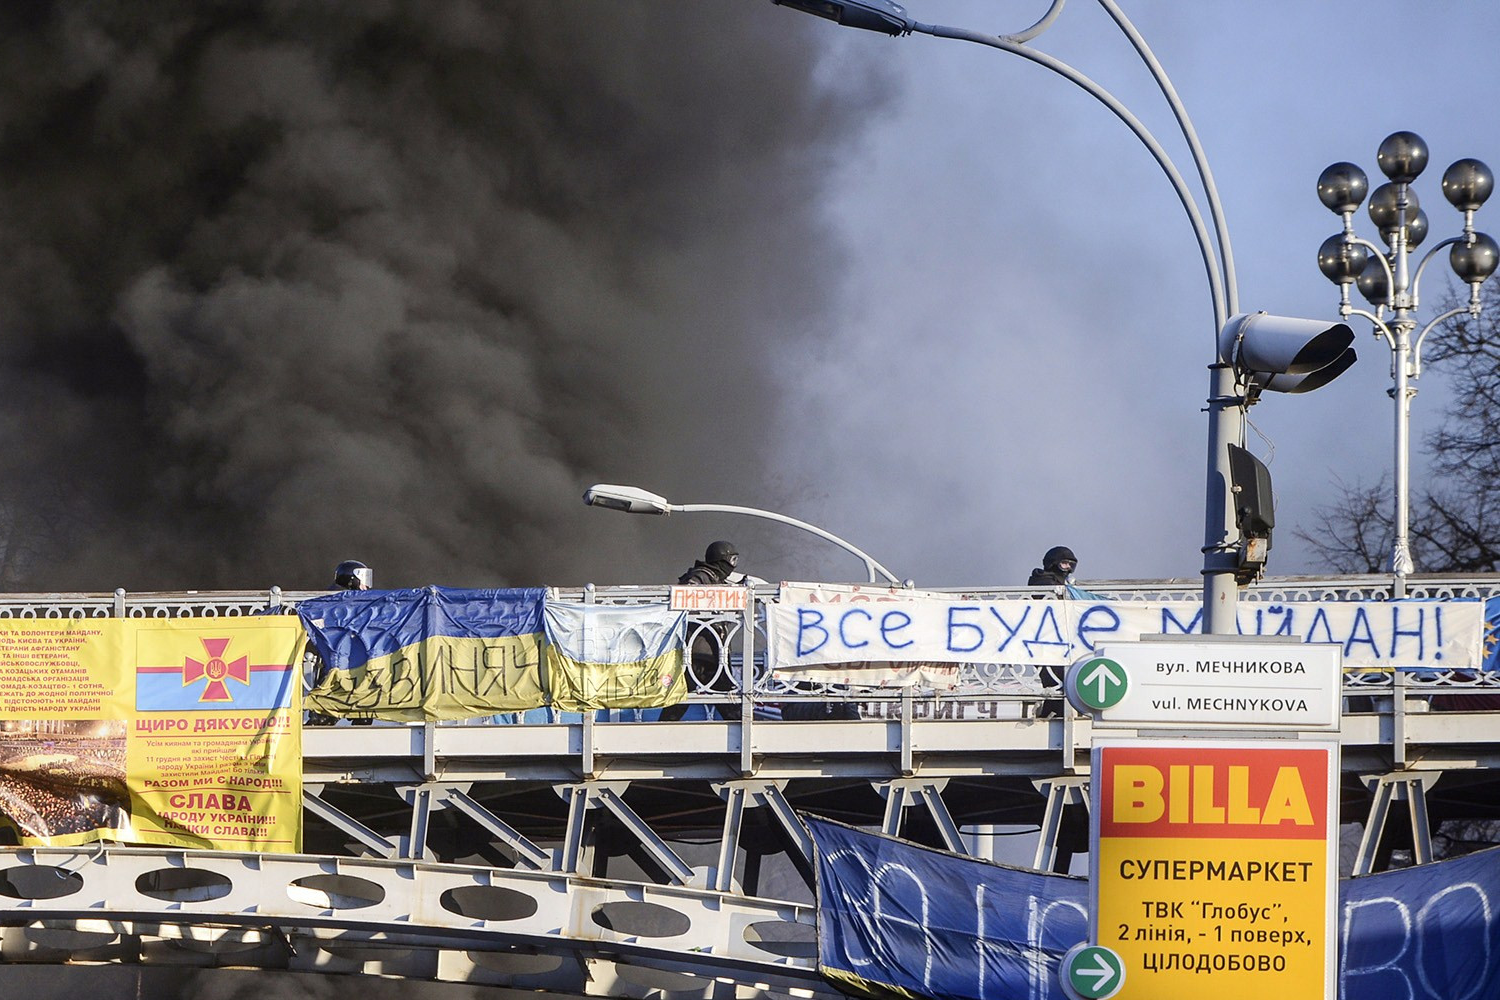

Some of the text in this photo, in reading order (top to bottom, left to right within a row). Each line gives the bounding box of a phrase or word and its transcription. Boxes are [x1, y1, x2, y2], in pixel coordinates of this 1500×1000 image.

[674, 588, 748, 610] ПИРЯТИН
[66, 629, 103, 637] МАЙДАНУ,
[1156, 660, 1306, 675] вул. МЕЧНИКОВА
[1152, 697, 1308, 712] vul. MECHNYKOVA
[135, 717, 291, 733] ЩИРО ДЯКУЄМО!!!
[144, 775, 283, 788] РАЗОМ МИ Є НАРОД!!!
[169, 793, 253, 812] СЛАВА
[1112, 764, 1315, 826] BILLA
[211, 812, 276, 825] УКРАЇНИ!!!
[213, 824, 268, 837] СЛАВА!!!
[1119, 859, 1313, 883] СУПЕРМАРКЕТ
[1141, 901, 1184, 919] ТВК
[1118, 924, 1129, 941] 2
[1134, 924, 1192, 945] лінія,
[1230, 928, 1312, 947] поверх,
[1143, 952, 1286, 974] ЦІЛОДОБОВО
